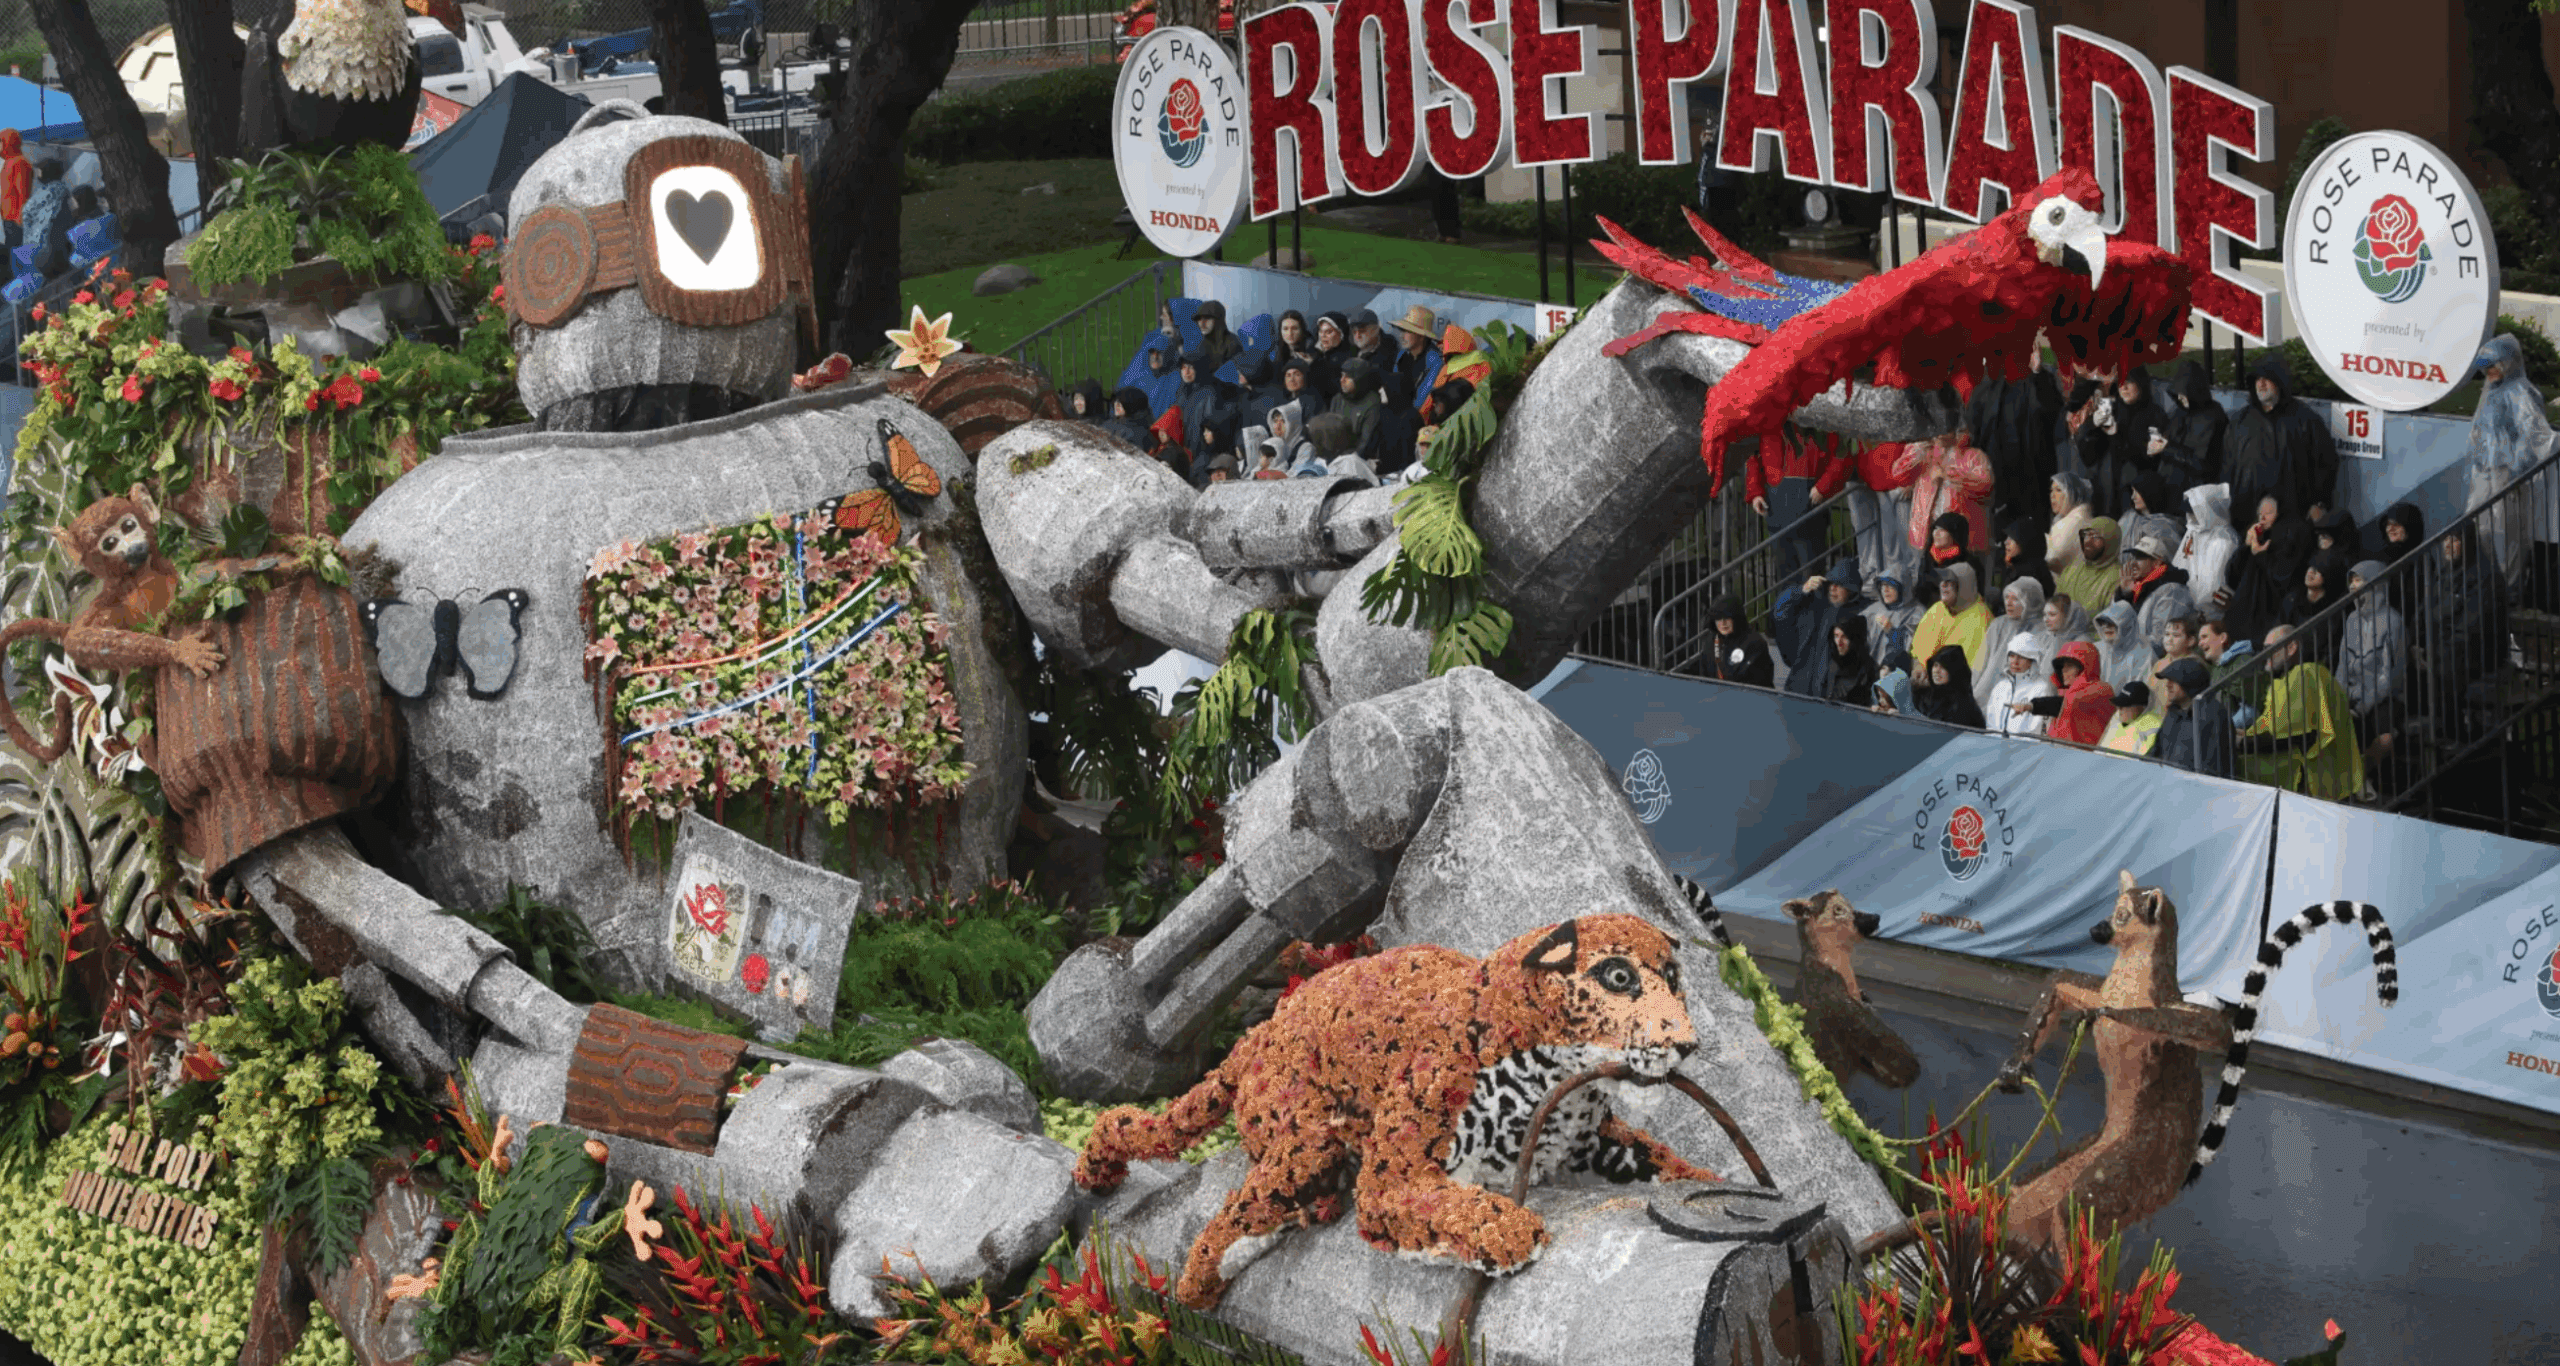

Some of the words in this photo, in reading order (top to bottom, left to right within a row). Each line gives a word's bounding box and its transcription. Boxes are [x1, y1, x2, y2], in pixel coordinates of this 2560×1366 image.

[1130, 48, 1164, 137] ROSE
[1170, 39, 1240, 147] PARADE
[1241, 0, 1607, 222] ROSE
[1628, 0, 2283, 347] PARADE
[1150, 210, 1221, 233] HONDA
[2309, 157, 2361, 264] ROSE
[2371, 147, 2479, 279] PARADE
[2363, 320, 2410, 339] presented
[2412, 324, 2426, 342] by
[2340, 352, 2449, 384] HONDA
[2345, 409, 2369, 438] 15
[1913, 779, 1949, 850] ROSE
[1956, 773, 2014, 869] PARADE
[1916, 911, 1985, 936] HONDA
[2503, 903, 2559, 984] ROSE
[2505, 1051, 2560, 1079] HON
[106, 1123, 151, 1175] CAL
[148, 1138, 216, 1192] POLY
[61, 1168, 219, 1250] UNIVERSITIES
